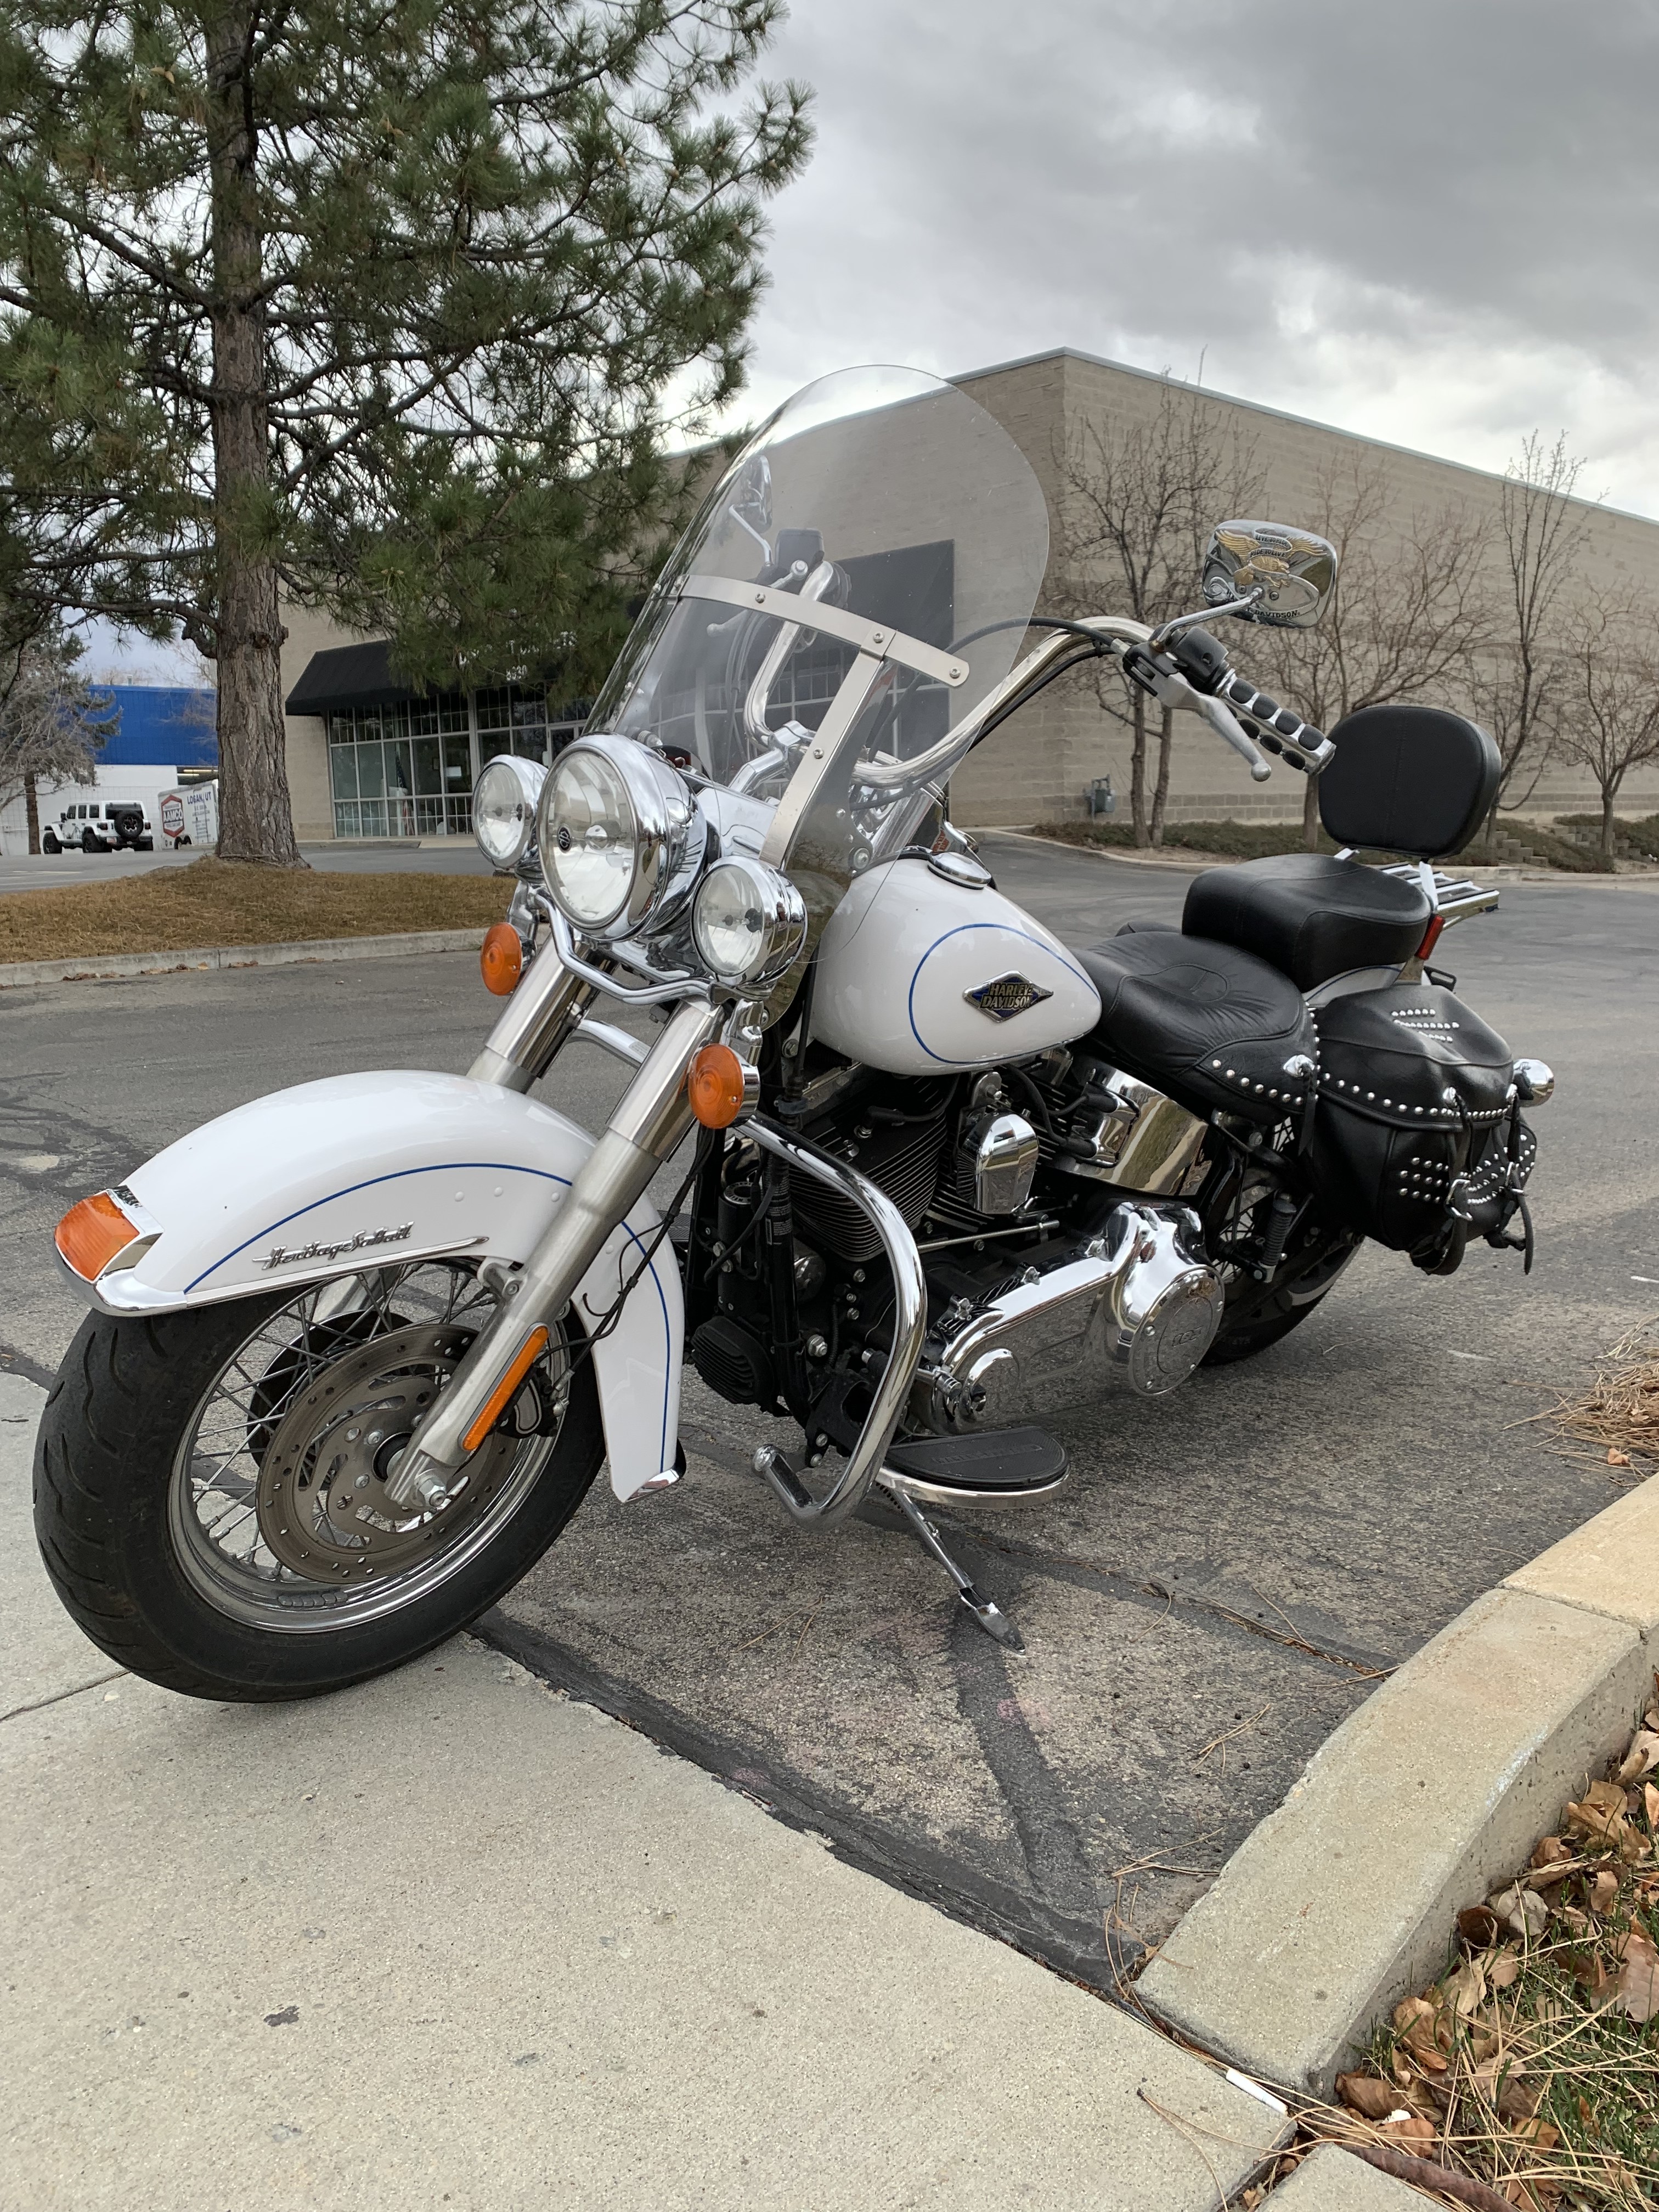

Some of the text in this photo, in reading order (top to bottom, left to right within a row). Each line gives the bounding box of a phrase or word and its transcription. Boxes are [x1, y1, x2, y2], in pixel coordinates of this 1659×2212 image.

[205, 792, 211, 800] UT
[163, 809, 183, 822] AAMCO
[981, 995, 1034, 1009] DAVIDSON
